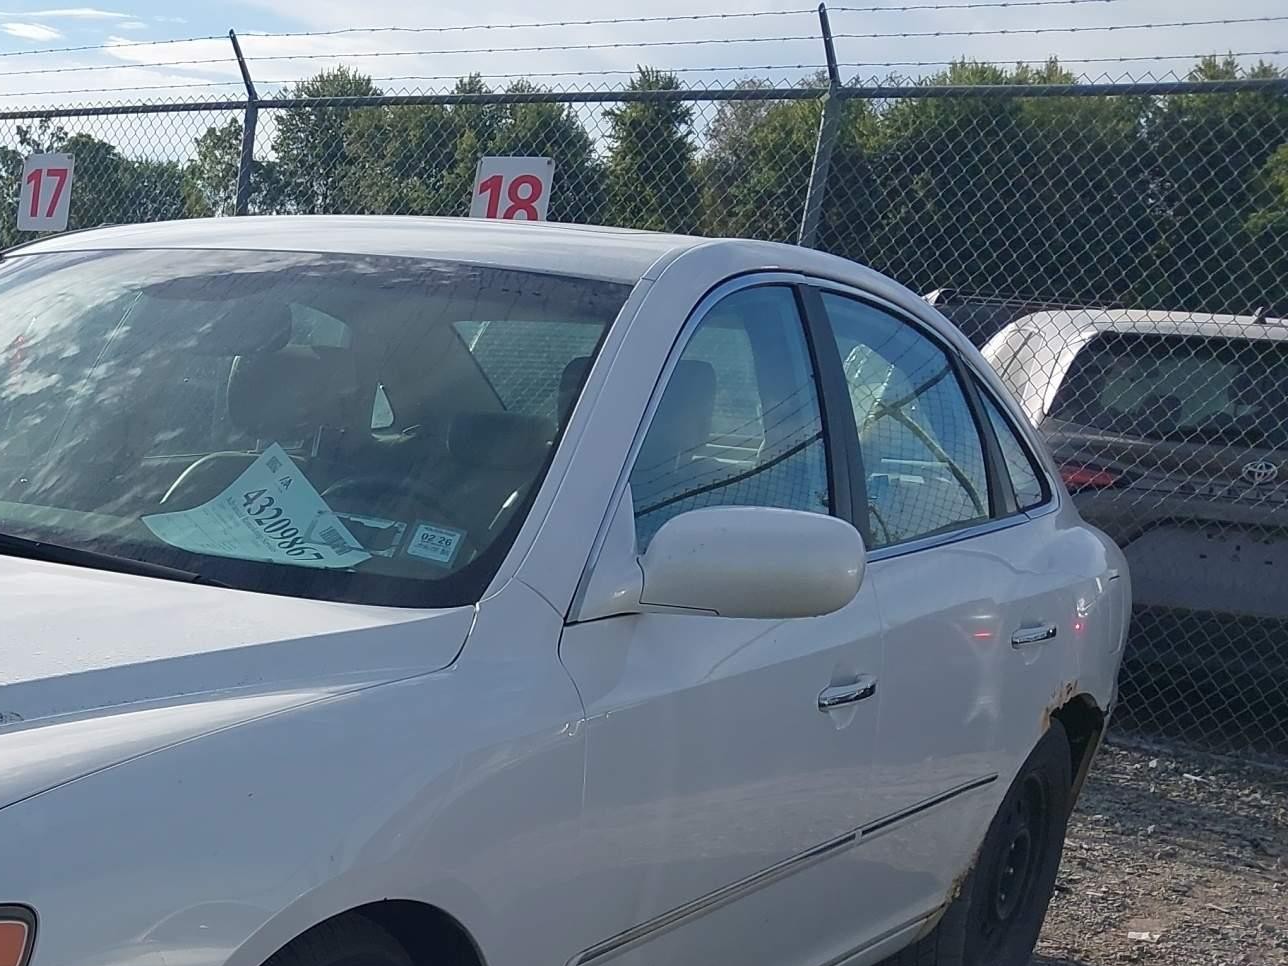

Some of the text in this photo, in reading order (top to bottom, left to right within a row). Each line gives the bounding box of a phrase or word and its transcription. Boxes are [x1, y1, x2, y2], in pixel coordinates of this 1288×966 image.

[26, 168, 68, 218] 17
[478, 174, 543, 221] 18
[242, 488, 324, 561] 43209867
